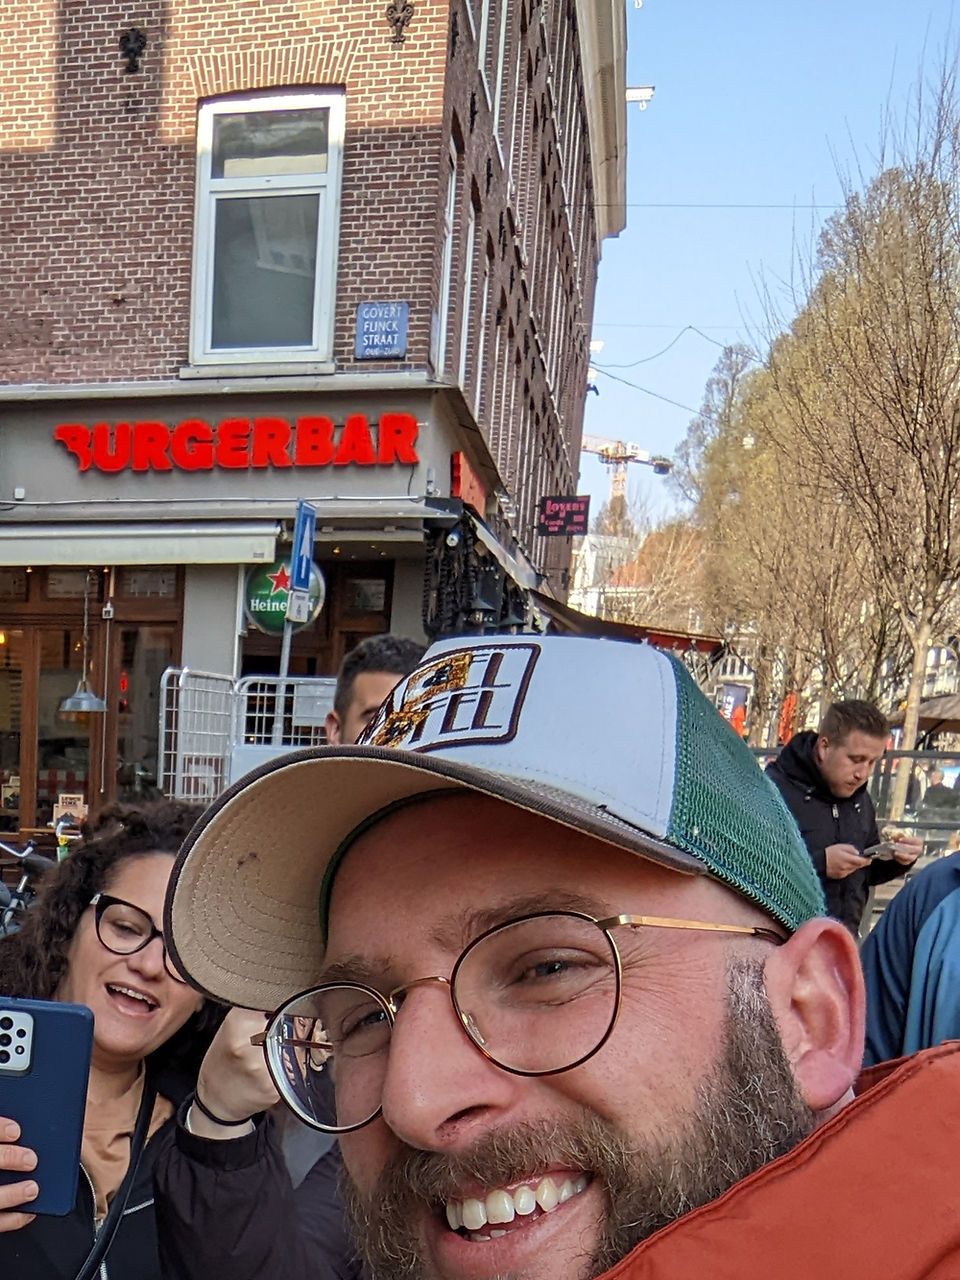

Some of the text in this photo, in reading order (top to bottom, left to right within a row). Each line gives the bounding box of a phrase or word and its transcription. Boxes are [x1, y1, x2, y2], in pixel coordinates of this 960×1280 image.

[363, 321, 399, 332] FLINCK
[362, 334, 399, 346] STRAAT
[54, 412, 420, 473] BURGERBAR
